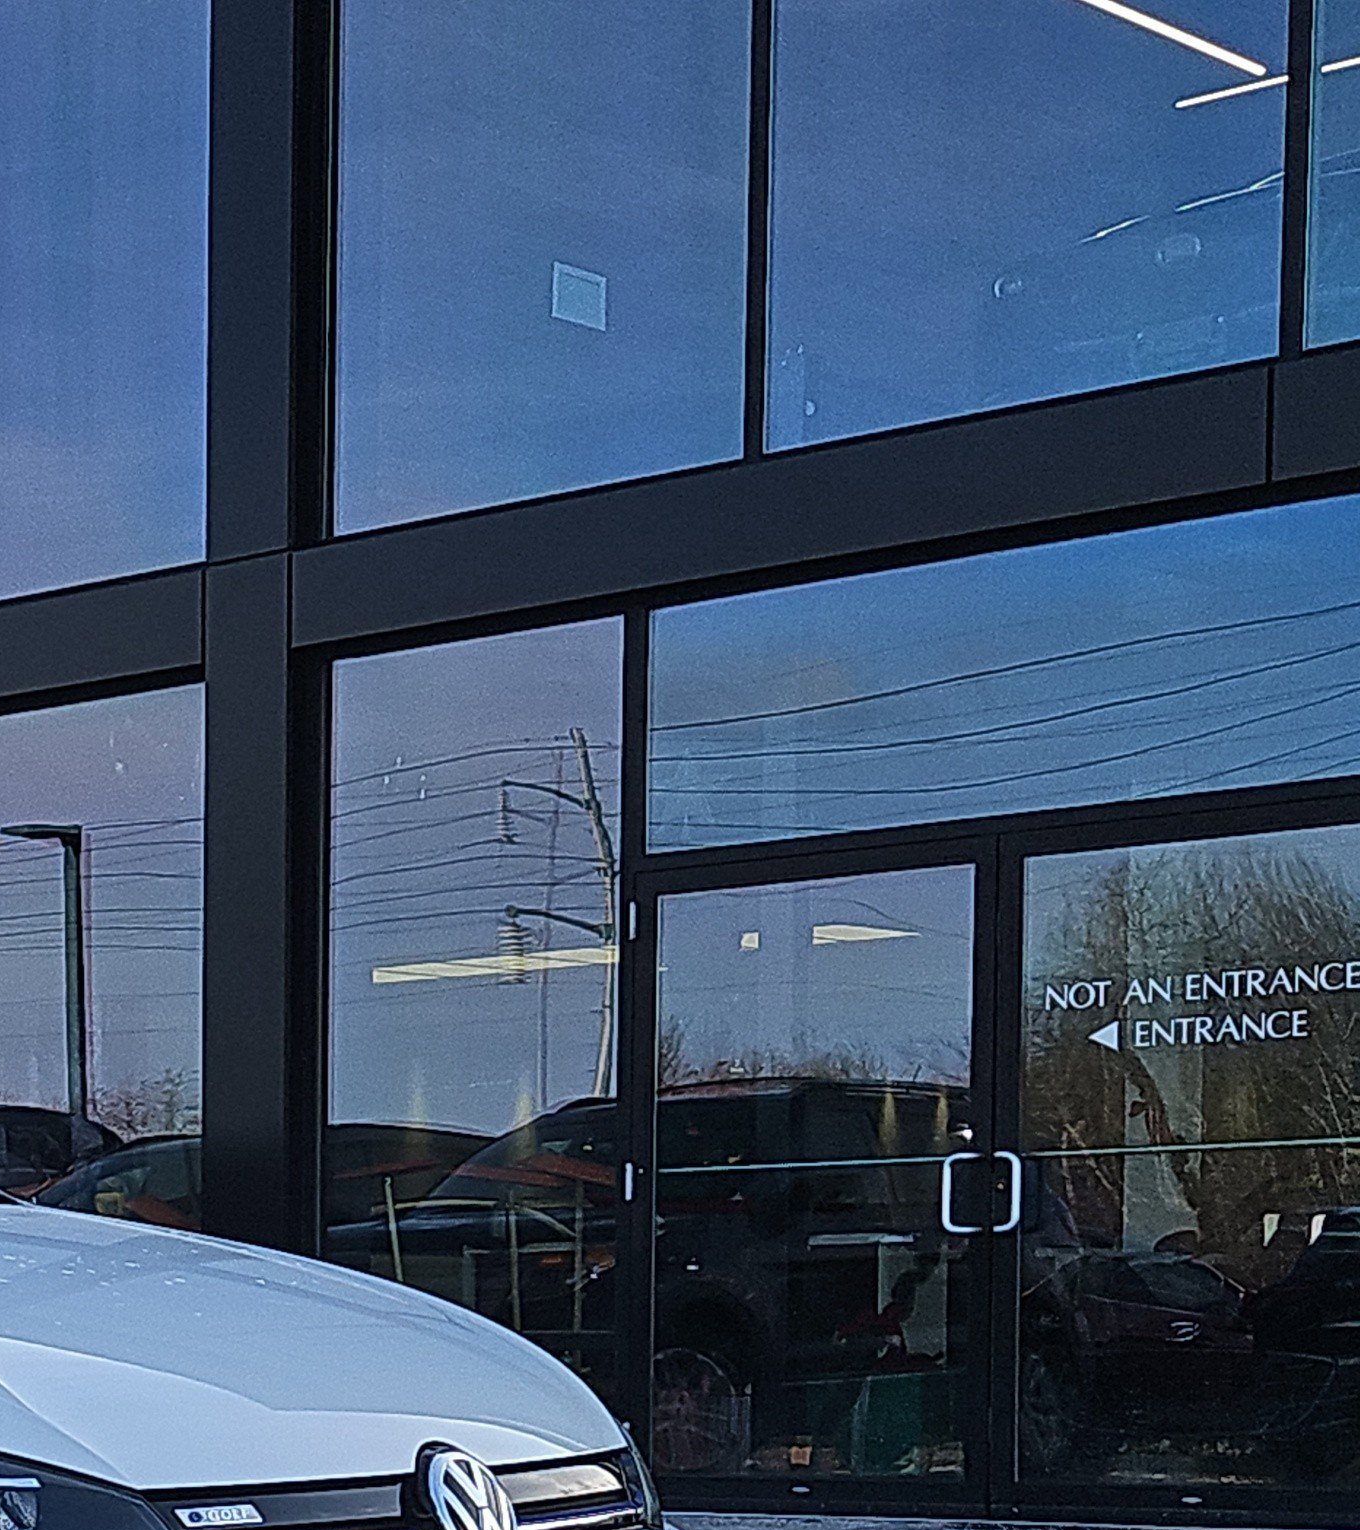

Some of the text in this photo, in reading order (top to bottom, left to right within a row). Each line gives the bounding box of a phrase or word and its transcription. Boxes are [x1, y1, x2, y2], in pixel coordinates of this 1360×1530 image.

[1045, 961, 1360, 1011] NOT AN ENTRANCE
[1134, 1009, 1308, 1047] ENTRANCE
